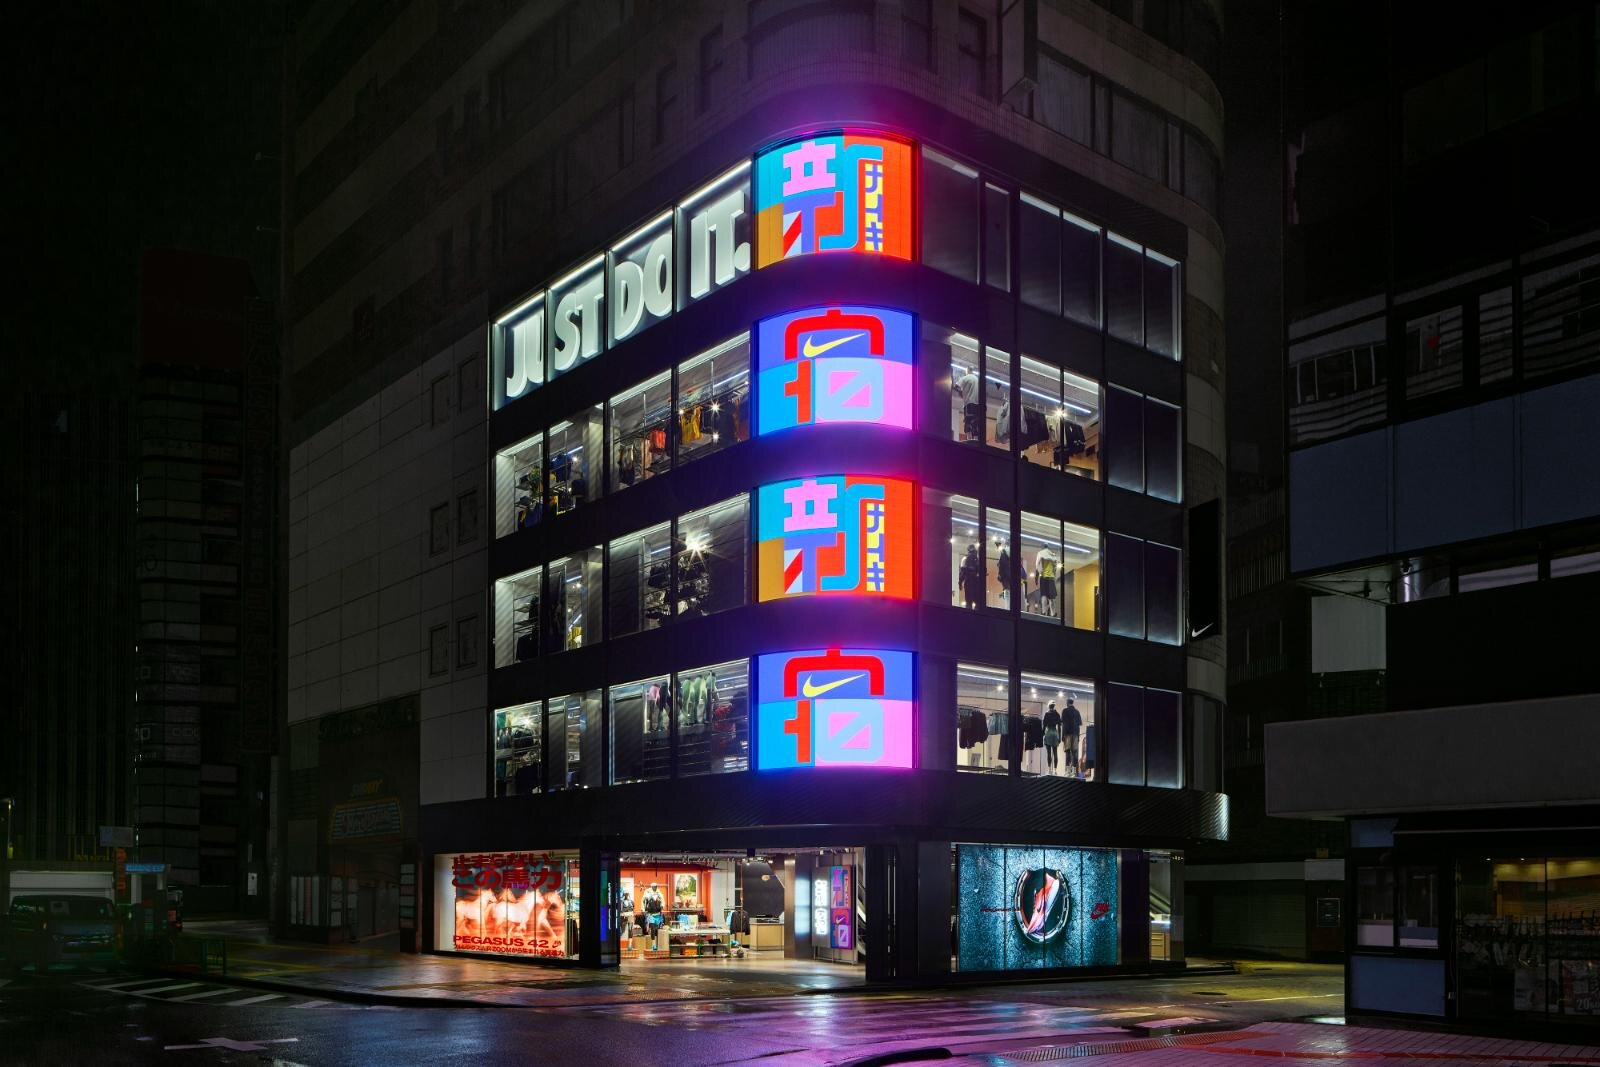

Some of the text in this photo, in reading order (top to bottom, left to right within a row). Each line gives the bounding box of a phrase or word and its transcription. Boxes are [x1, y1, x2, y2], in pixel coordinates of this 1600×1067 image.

[783, 141, 884, 254] 新
[507, 190, 752, 398] JUST DO IT.
[784, 309, 885, 424] 宿
[783, 480, 885, 592] 新
[783, 648, 885, 763] 宿
[451, 868, 563, 889] この馬力
[453, 935, 524, 947] PEGASUS
[527, 939, 549, 949] 42
